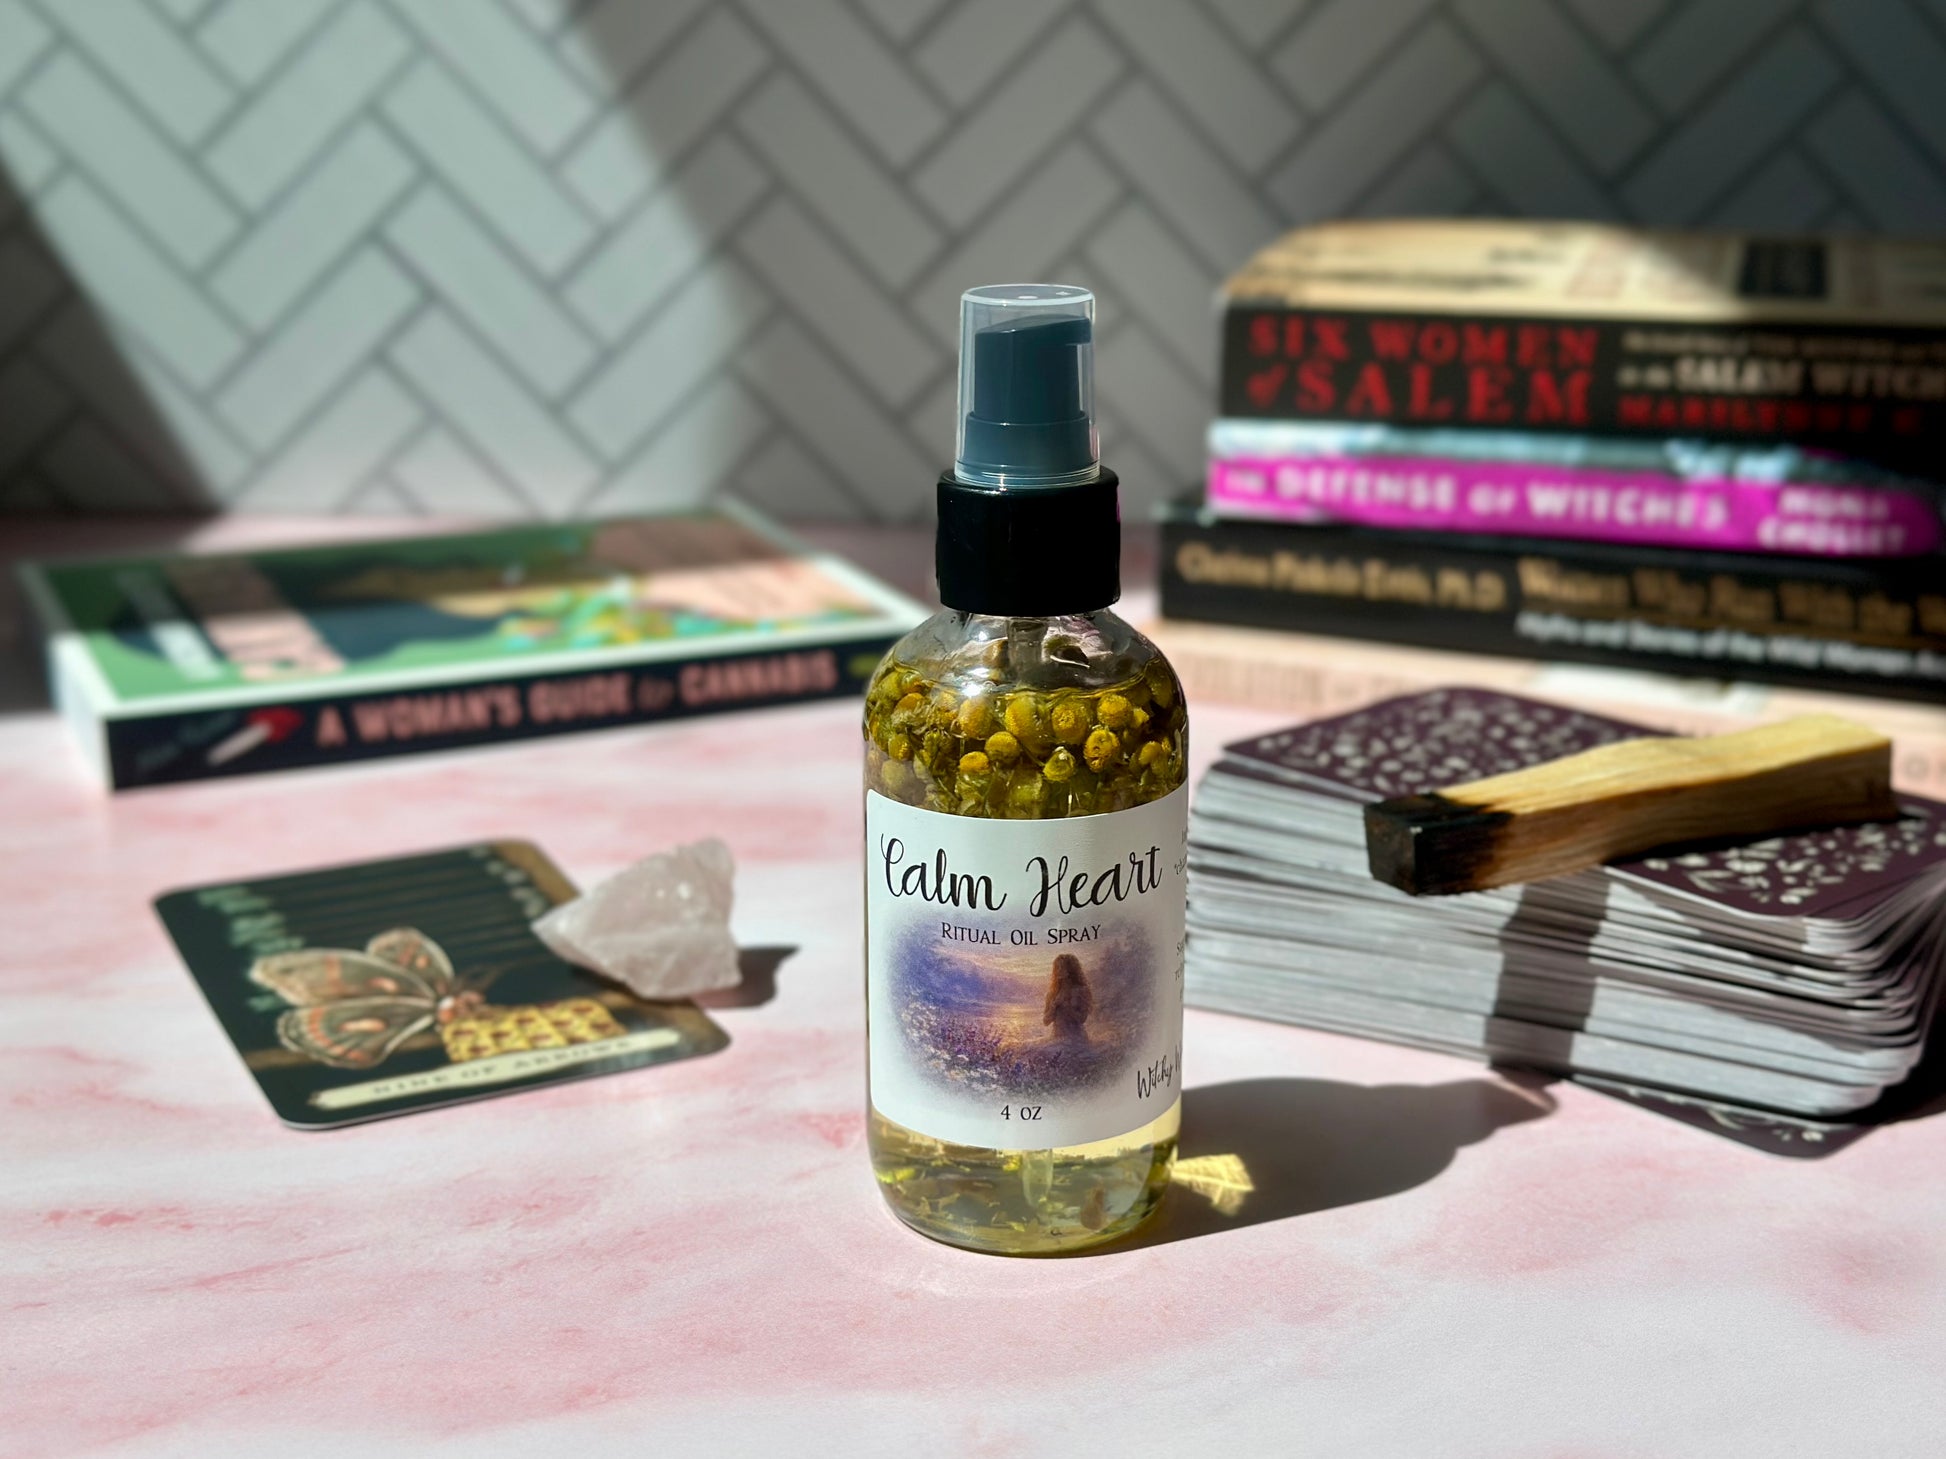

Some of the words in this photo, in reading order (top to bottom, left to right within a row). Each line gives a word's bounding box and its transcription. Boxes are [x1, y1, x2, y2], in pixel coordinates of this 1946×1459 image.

[1250, 316, 1349, 360] SIX
[1369, 320, 1598, 369] WOMEN
[1295, 359, 1594, 426] SALEM
[1674, 355, 1803, 395] SALEM
[1275, 464, 1457, 513] DEFENSE
[1526, 481, 1728, 532] WITCHES
[317, 706, 347, 747] A
[352, 683, 524, 743] WOMAN'S
[528, 673, 632, 724] GUIDE
[680, 650, 837, 706] CANNABIS
[881, 833, 1007, 911] Calm
[1026, 846, 1162, 917] Heart
[942, 922, 1001, 945] RITUAL
[1010, 929, 1038, 946] OIL
[1048, 924, 1101, 945] SPRAY
[461, 1062, 498, 1080] OF
[1137, 1053, 1174, 1100] Witchy
[1000, 1106, 1011, 1121] 4
